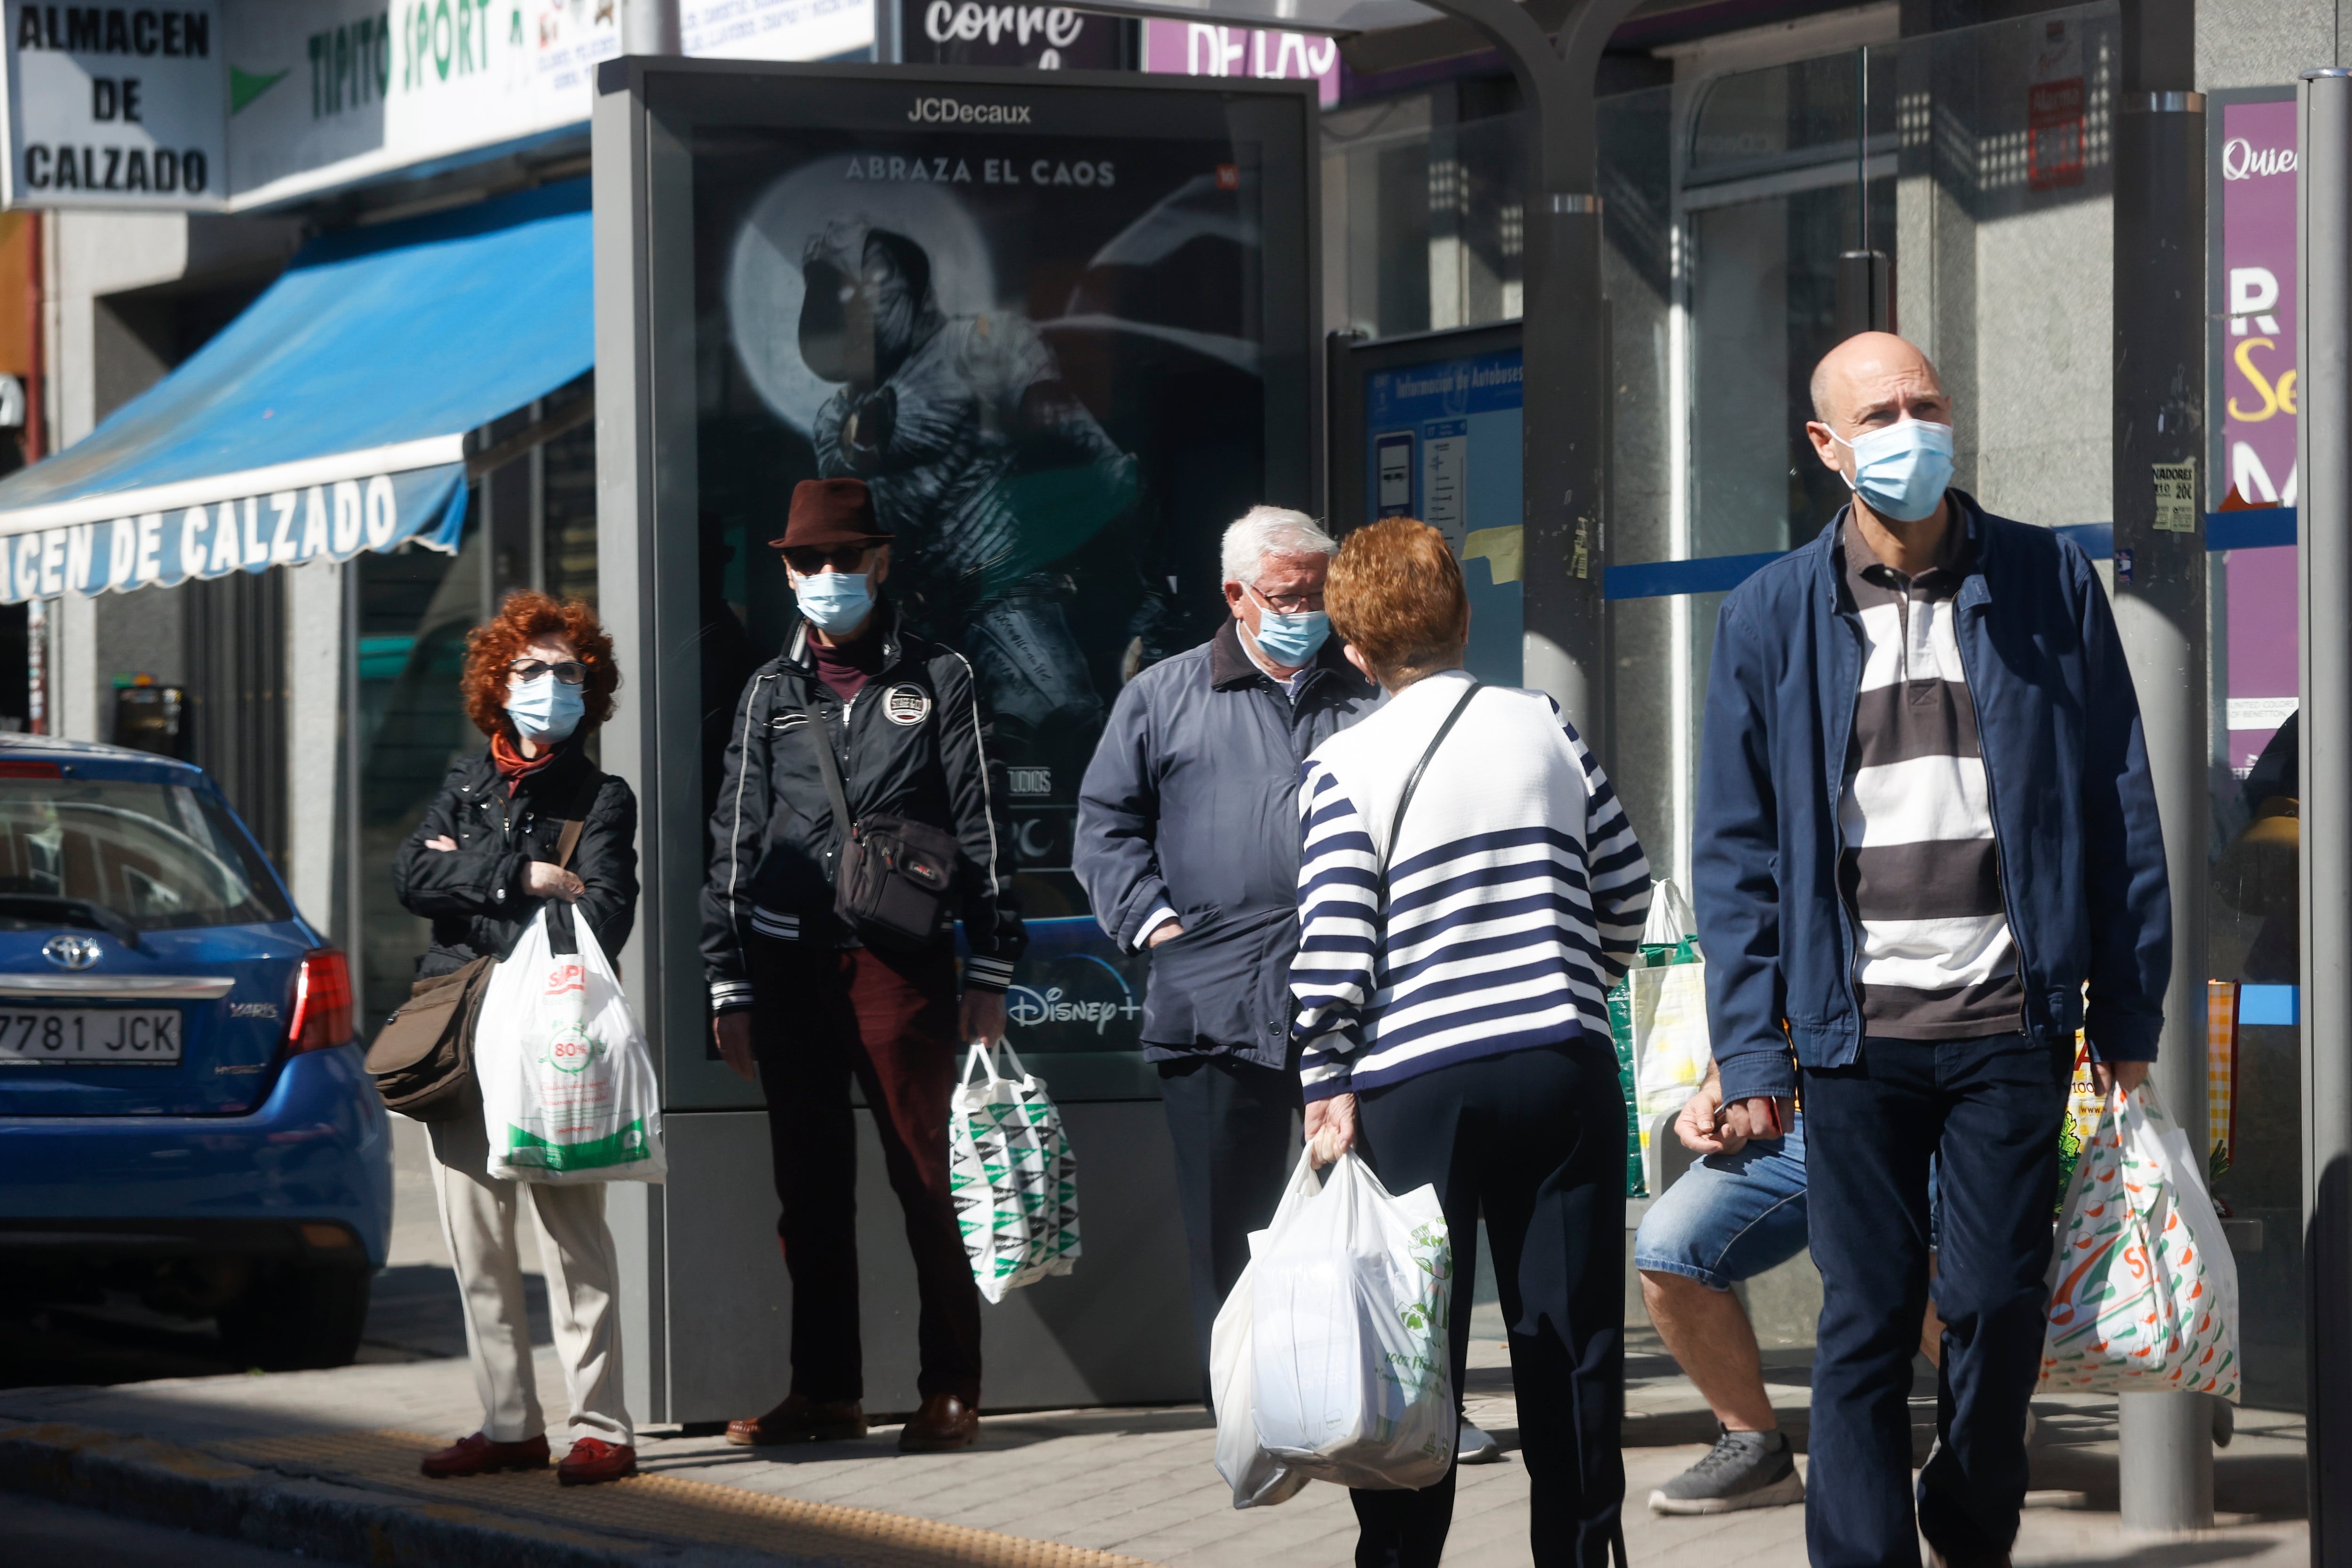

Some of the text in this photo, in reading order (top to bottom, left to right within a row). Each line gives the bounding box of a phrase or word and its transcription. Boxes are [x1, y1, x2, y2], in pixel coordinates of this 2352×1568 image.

[18, 6, 208, 58] ALMACEN
[925, 0, 1084, 48] corre
[309, 13, 390, 119] TIPITO
[405, 0, 490, 91] SPORT
[93, 78, 142, 122] DE
[908, 98, 1032, 124] JCDecaux
[26, 144, 207, 192] CALZADO
[845, 156, 1115, 187] ABRAZA EL CAOS
[2223, 137, 2297, 181] Quie
[1472, 363, 1523, 388] Autobuses
[109, 513, 163, 584] DE
[181, 475, 396, 575] CALZADO
[2263, 700, 2295, 708] COLORS
[0, 1016, 175, 1051] 7781 JCK
